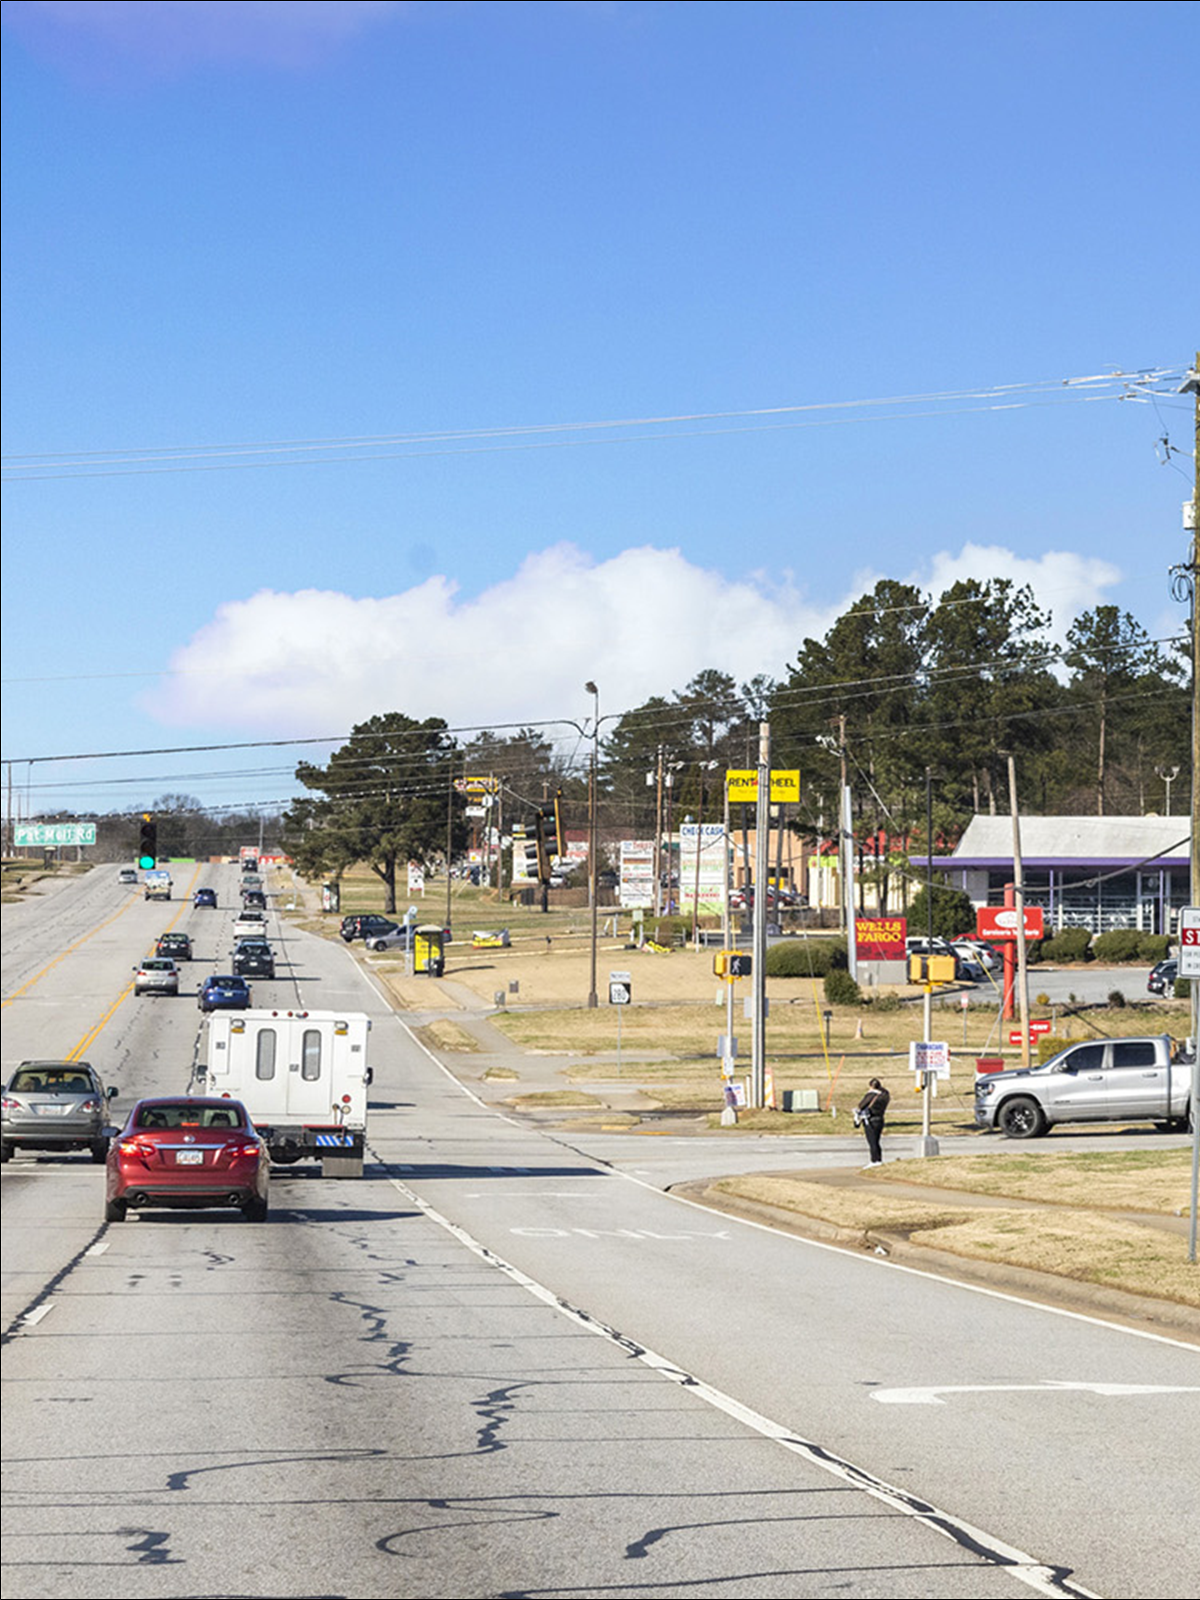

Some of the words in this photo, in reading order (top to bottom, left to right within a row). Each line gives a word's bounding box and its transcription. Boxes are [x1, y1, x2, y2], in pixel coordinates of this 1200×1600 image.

[76, 826, 93, 840] Rd
[856, 921, 902, 932] WELLS
[857, 932, 902, 942] FARGO
